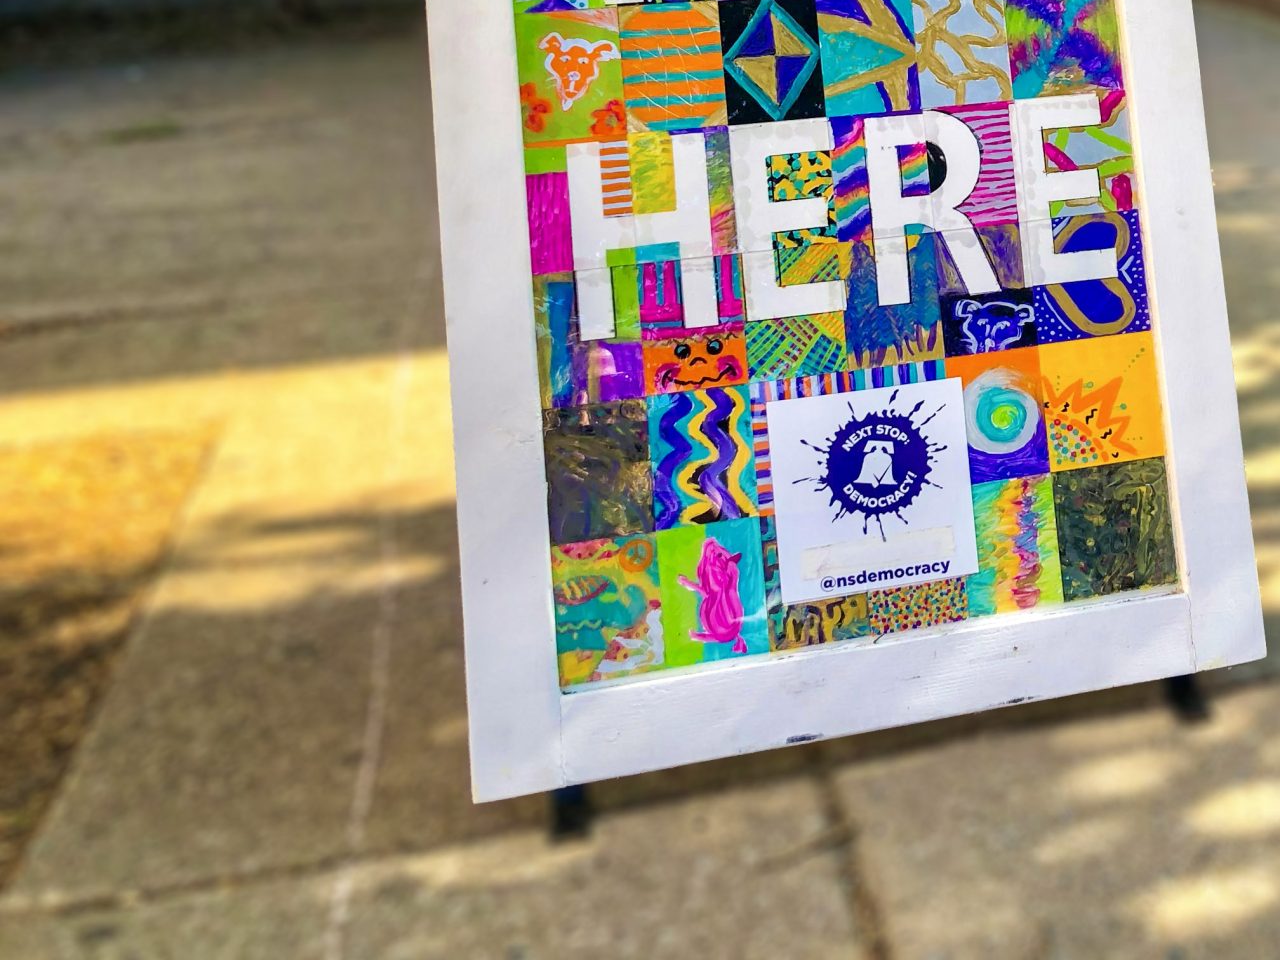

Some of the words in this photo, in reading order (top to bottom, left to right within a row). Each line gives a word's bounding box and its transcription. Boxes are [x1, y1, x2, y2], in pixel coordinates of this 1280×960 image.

[565, 93, 1118, 341] HERE
[842, 425, 873, 452] NEXT
[876, 424, 910, 445] STOP:
[842, 471, 917, 508] DEMOCRACY!
[820, 560, 950, 592] @nsdemocracy
